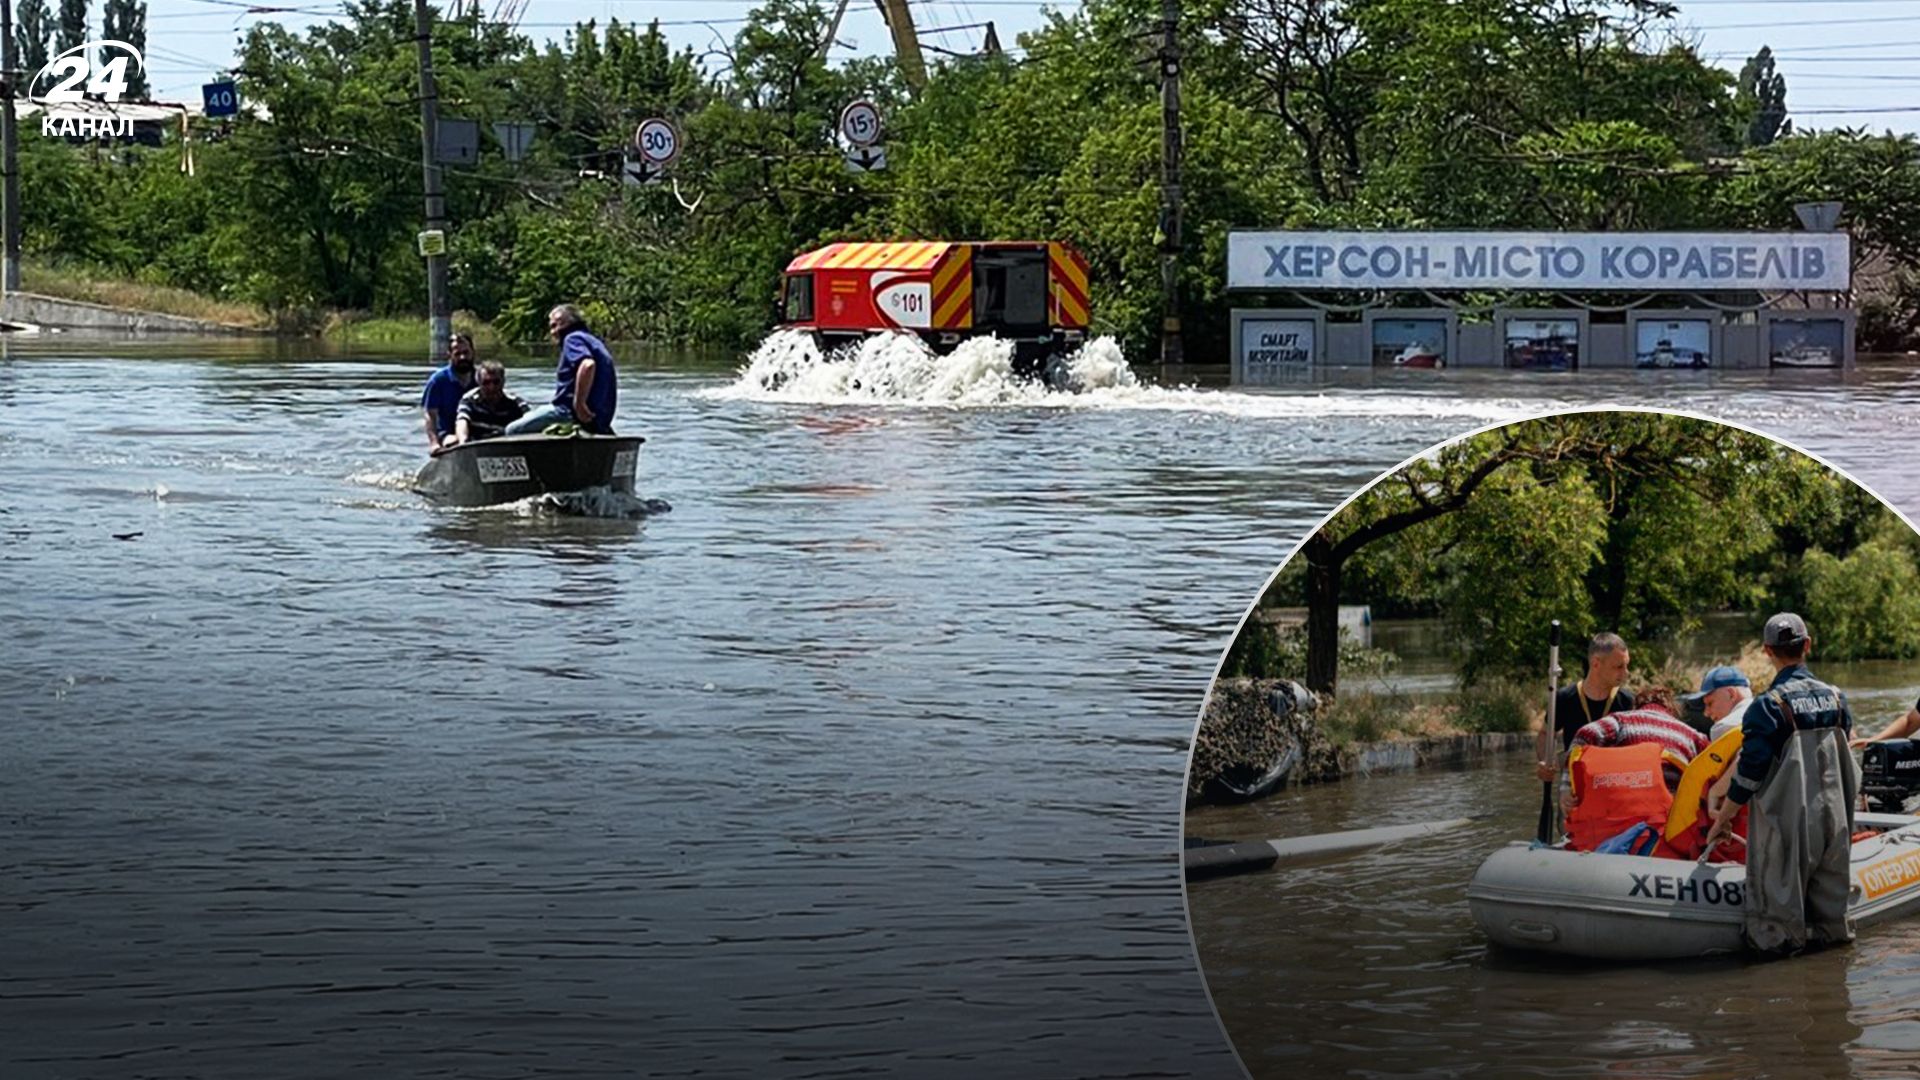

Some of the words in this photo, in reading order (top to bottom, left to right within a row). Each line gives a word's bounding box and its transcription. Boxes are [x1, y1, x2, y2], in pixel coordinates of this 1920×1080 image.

[208, 90, 232, 107] 40
[1601, 246, 1826, 279] КОРАБЕЛІВ
[902, 293, 923, 312] 101
[1260, 333, 1299, 347] СМАРТ
